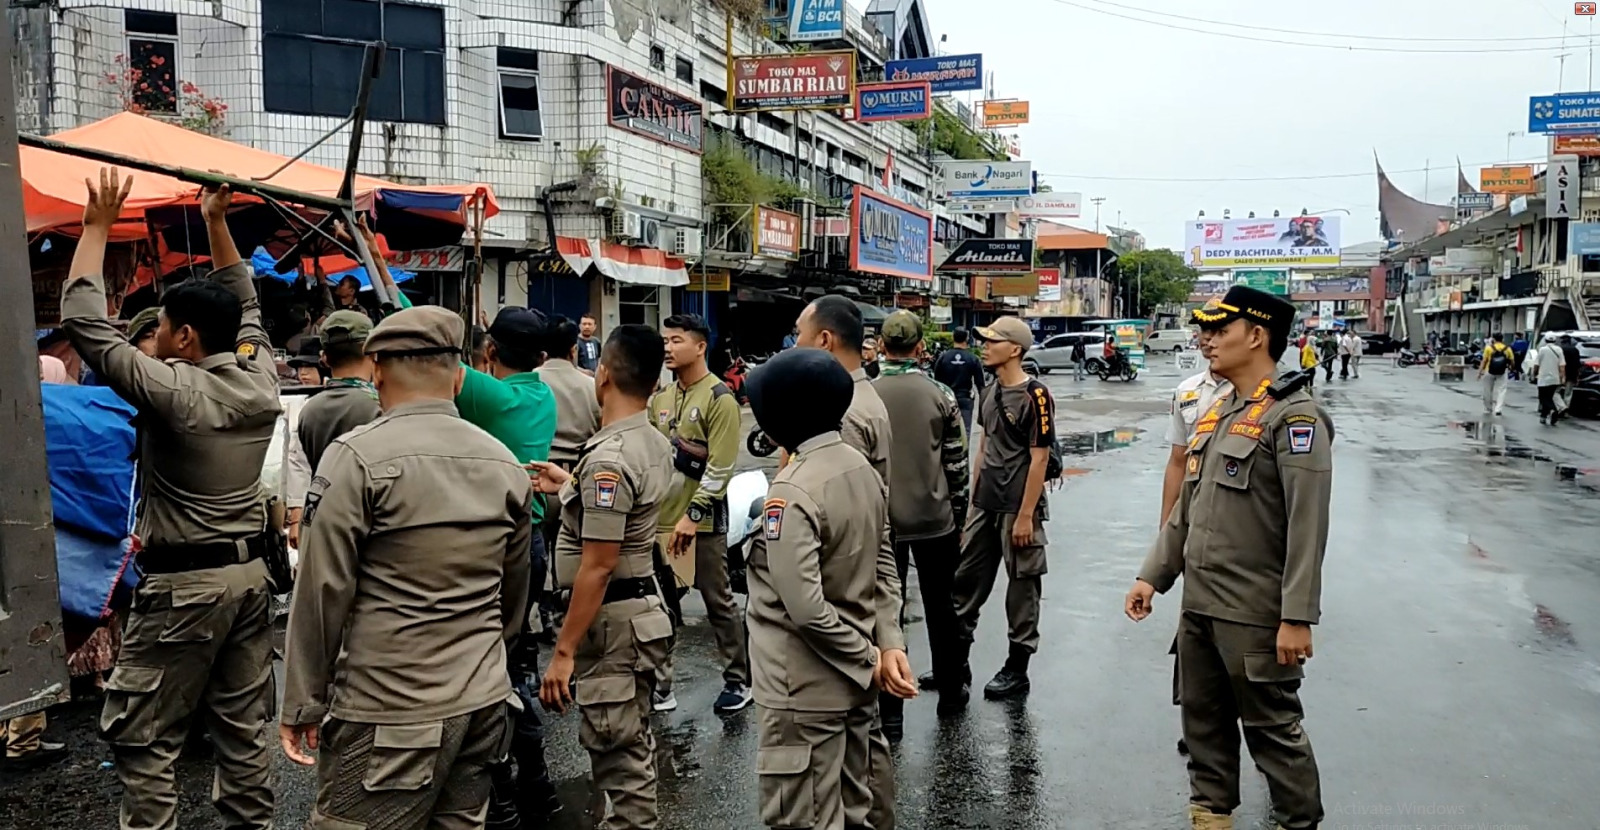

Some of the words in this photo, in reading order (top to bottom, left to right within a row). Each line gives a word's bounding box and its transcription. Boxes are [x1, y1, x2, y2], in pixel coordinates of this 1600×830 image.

[818, 11, 841, 22] BCA
[768, 67, 795, 77] TOKO
[797, 66, 817, 76] MAS
[739, 77, 804, 95] SUMBAR
[806, 75, 847, 92] RIAU
[879, 90, 924, 104] MURNI
[1559, 98, 1585, 106] TOKO
[620, 86, 696, 138] CANTIK
[1558, 107, 1600, 119] SUMATE
[955, 170, 978, 180] Bank
[992, 169, 1023, 181] Nagari
[1557, 165, 1569, 214] ASIA
[955, 250, 1024, 262] Atlantis
[1191, 245, 1203, 267] 1
[1205, 249, 1232, 258] DEDY
[1234, 248, 1287, 258] BACHTIAR,
[1289, 248, 1309, 257] S.T.,
[1311, 247, 1336, 256] M.M.
